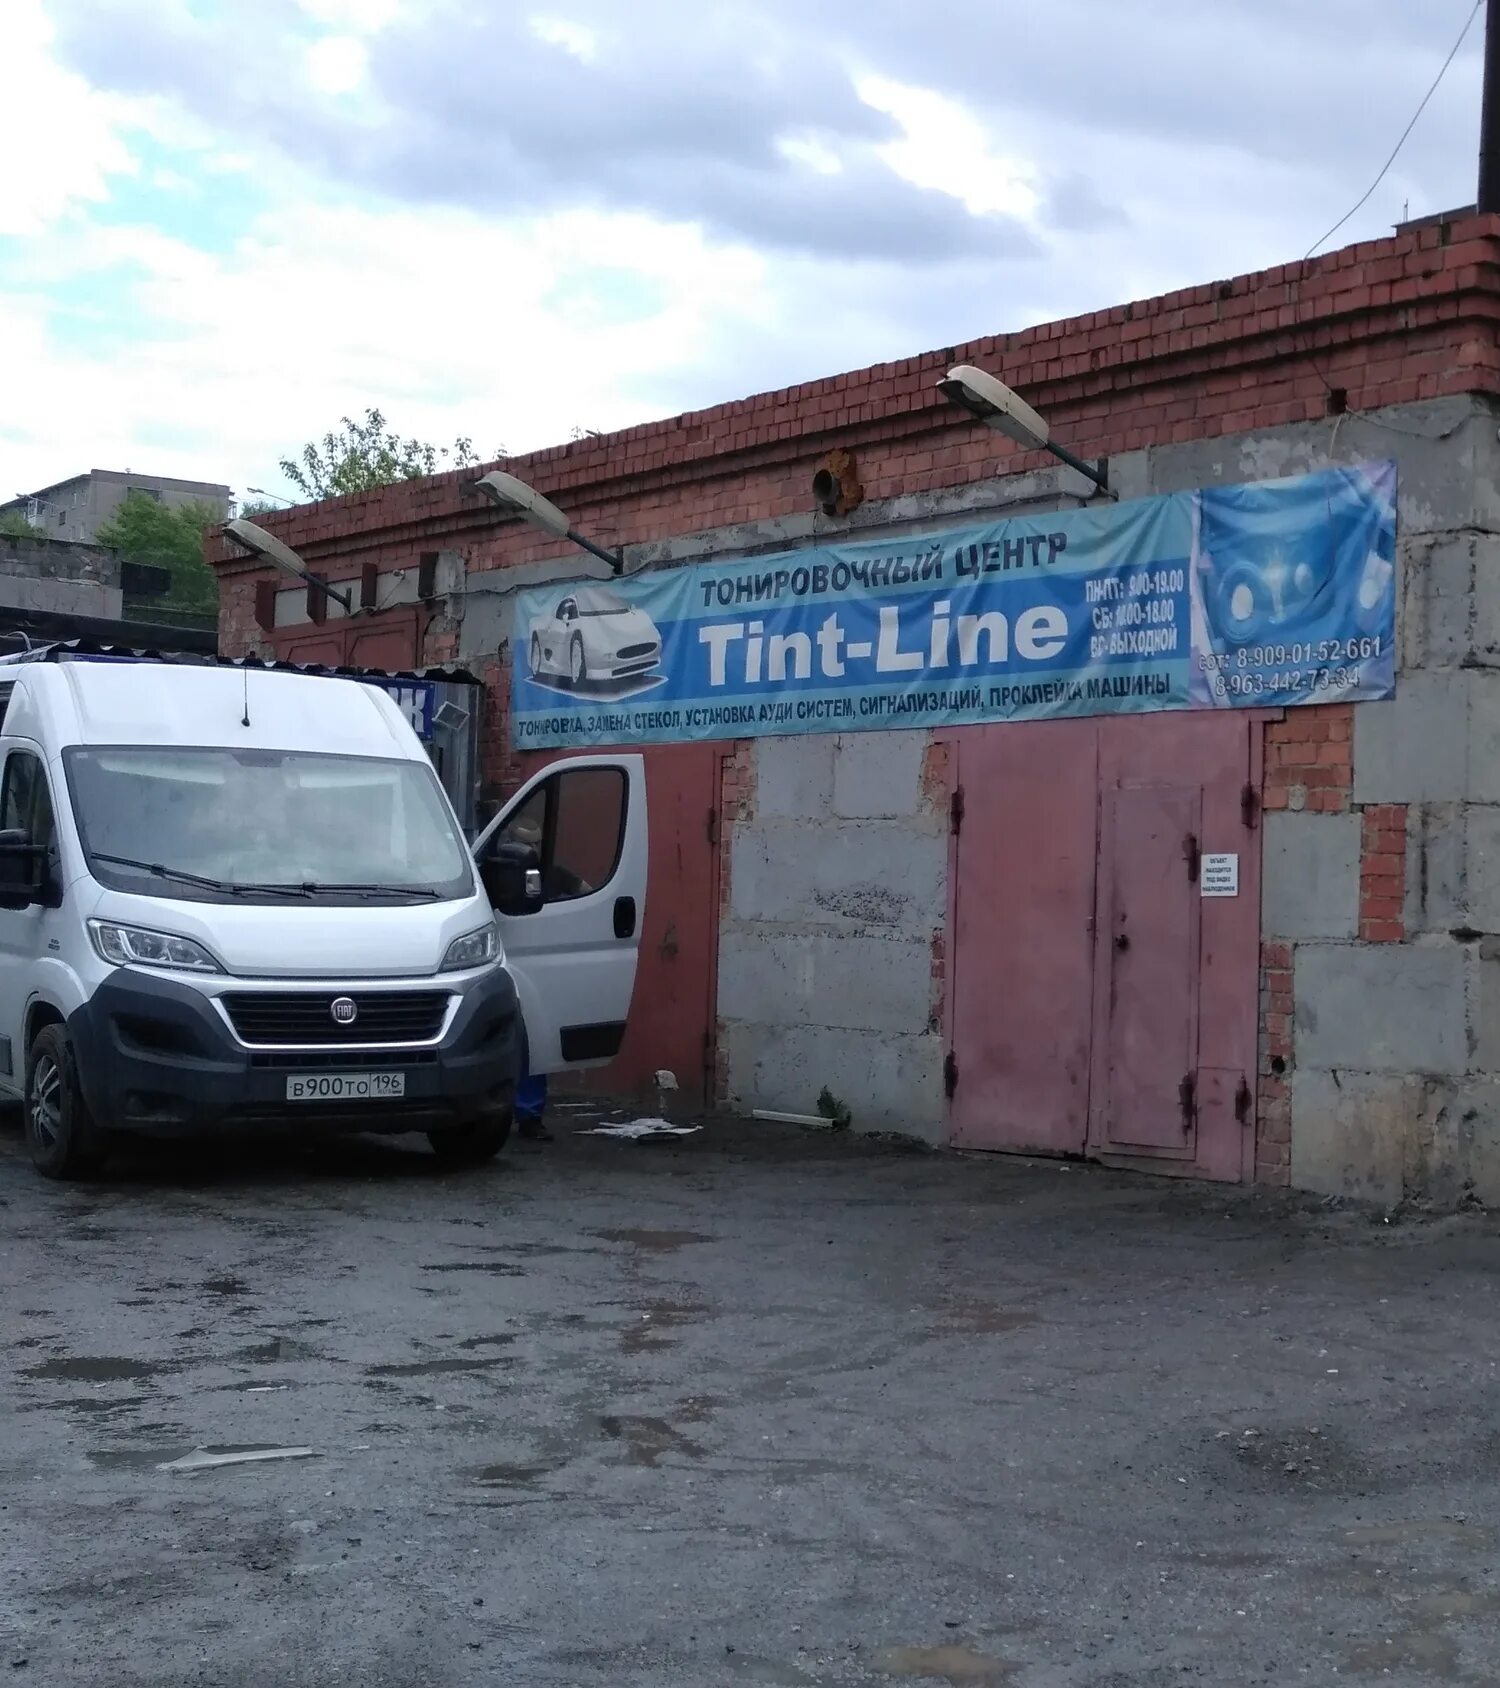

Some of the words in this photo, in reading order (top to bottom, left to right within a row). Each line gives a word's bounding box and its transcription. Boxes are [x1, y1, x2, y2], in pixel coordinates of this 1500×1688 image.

[701, 545, 944, 608] ТОНИРОВОЧНЫЙ
[955, 532, 1068, 580] ЦЕНТР
[699, 600, 1068, 687] Tint-Line
[1236, 636, 1382, 669] 8-909-01-52-661
[1215, 667, 1361, 697] 8-963-442-73-34
[587, 714, 631, 732] ЗАМЕНА
[634, 708, 683, 730] СТЕКОЛ,
[685, 705, 755, 726] УСТАНОВКА
[758, 702, 793, 724] АУДИ
[796, 698, 856, 720] СИСТЕМ,
[989, 677, 1082, 707] ПРОКЛЕЙКА
[1087, 672, 1170, 699] МАШИНЫ
[336, 1004, 353, 1018] FIAT
[372, 1074, 401, 1089] 196
